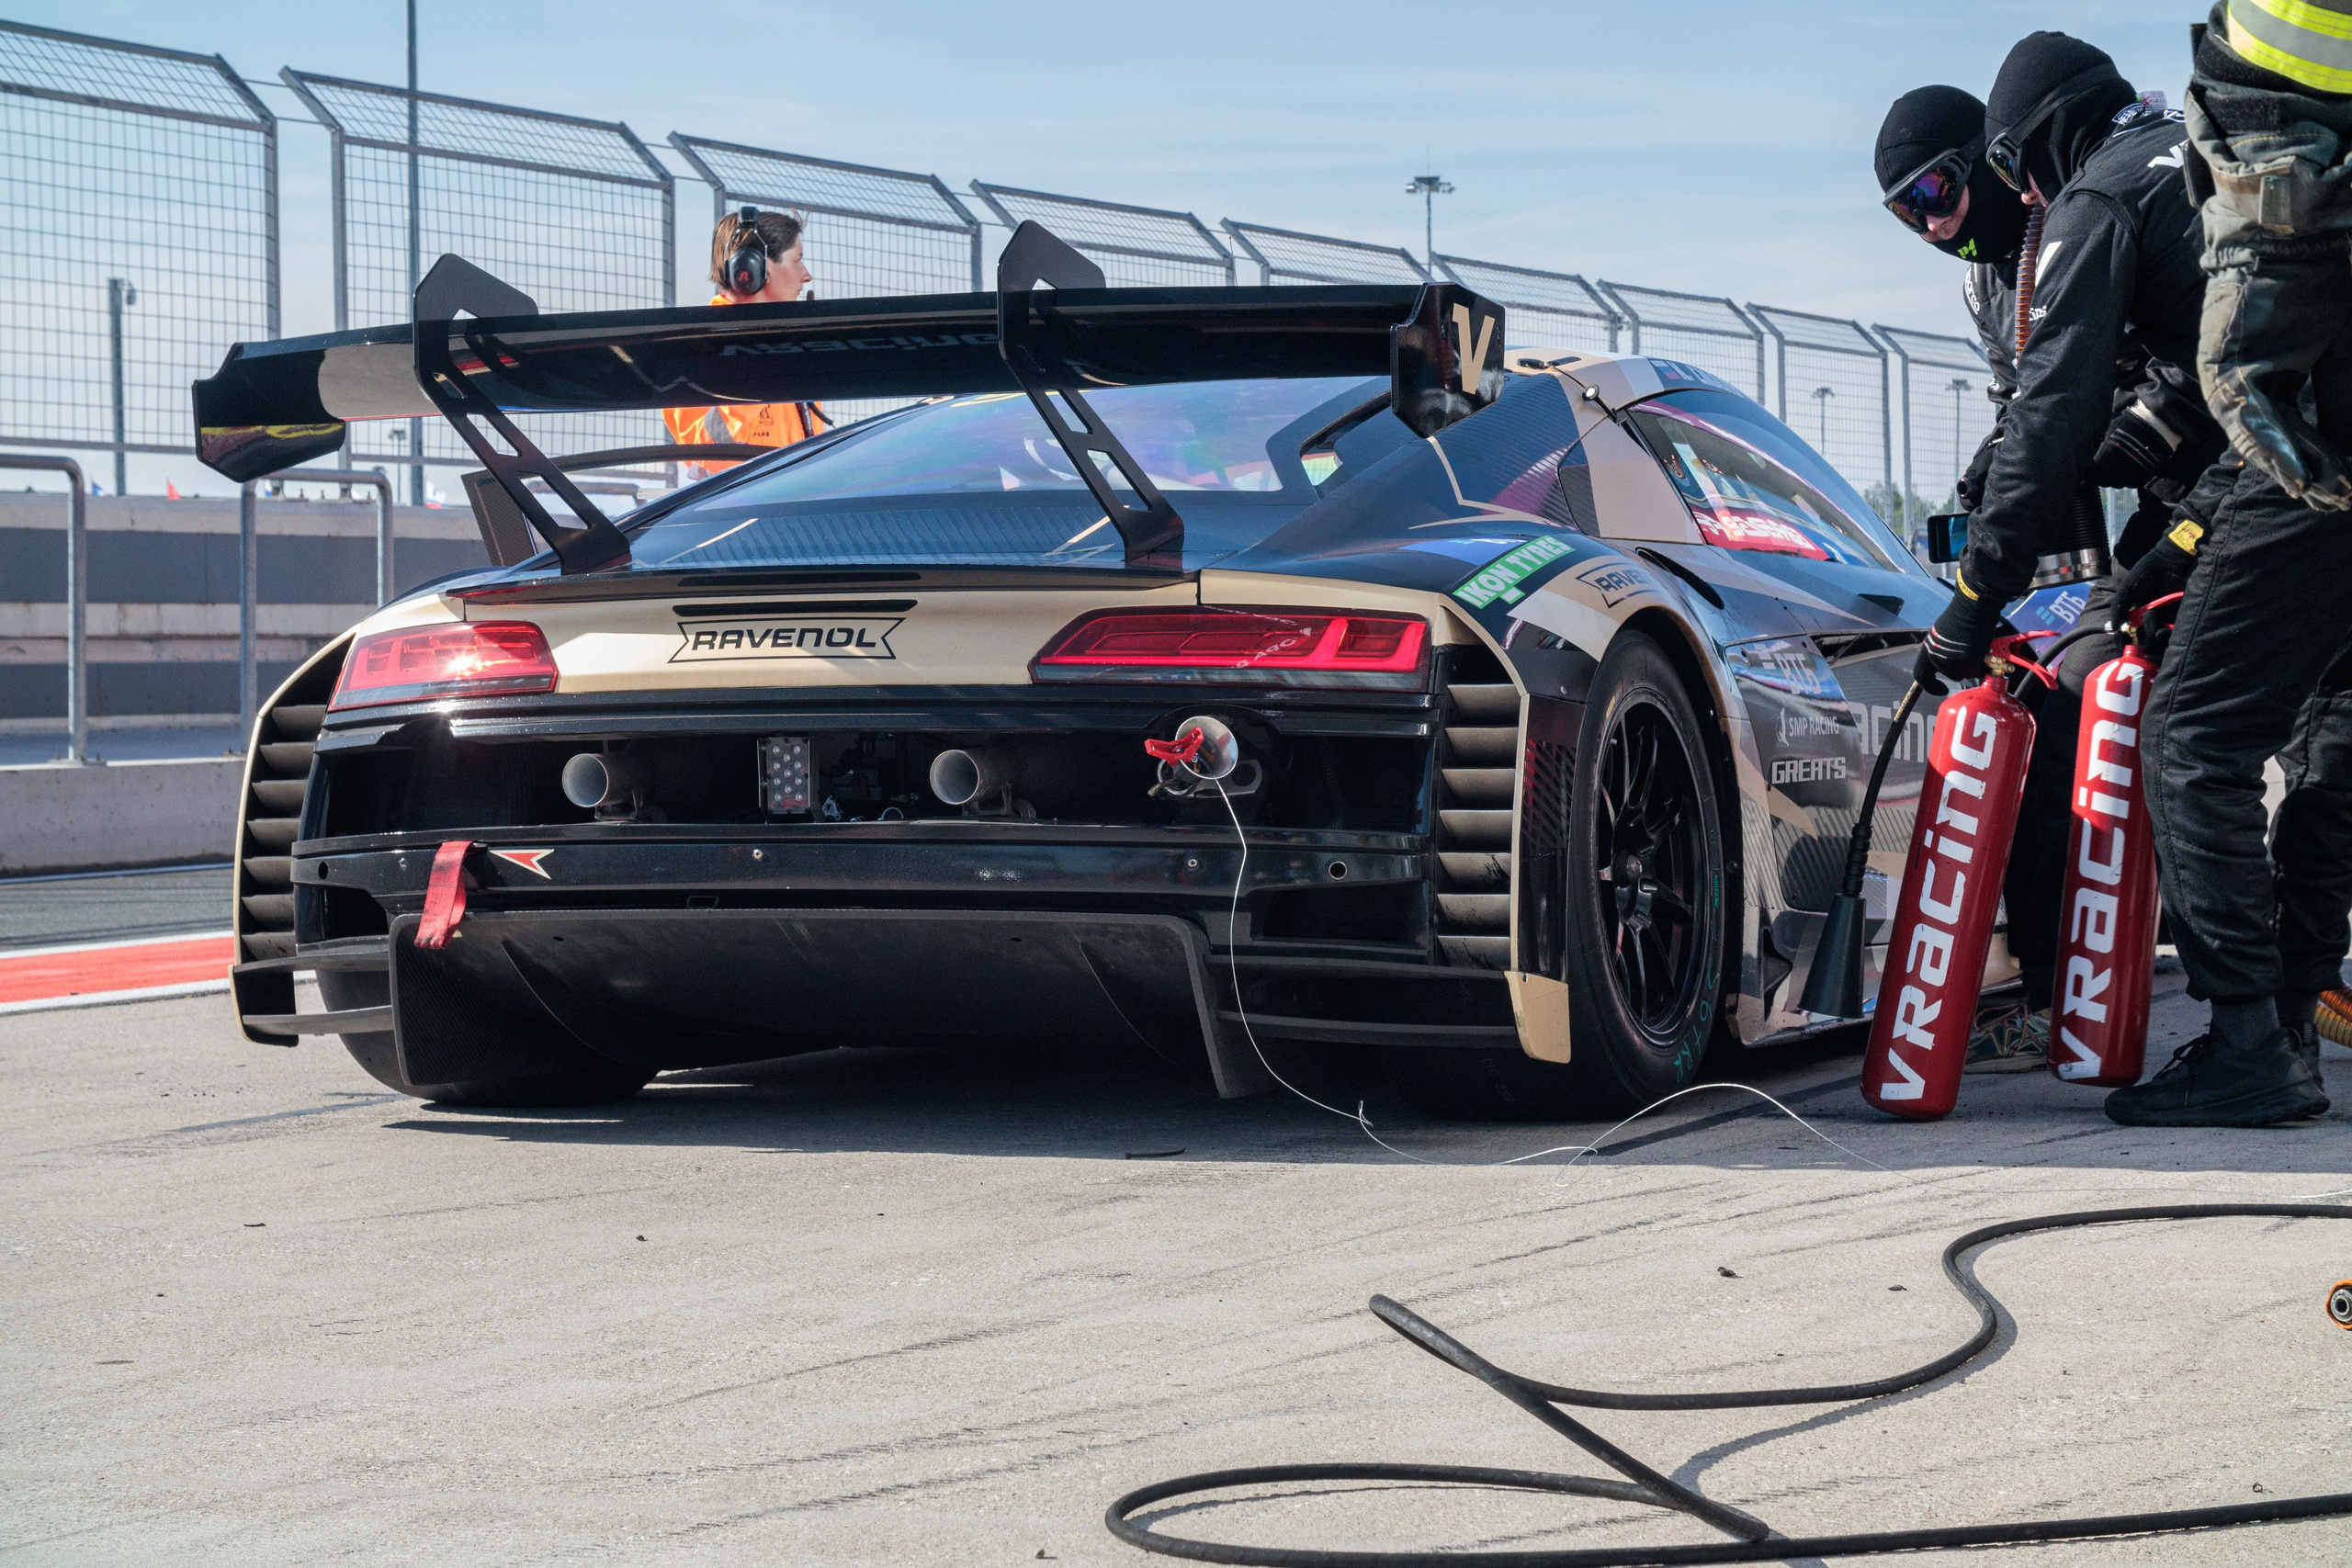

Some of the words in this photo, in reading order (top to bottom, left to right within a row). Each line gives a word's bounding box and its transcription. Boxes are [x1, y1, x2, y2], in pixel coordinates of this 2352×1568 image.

[1452, 302, 1496, 395] V
[1457, 563, 1521, 607] IKON
[1508, 536, 1572, 571] TYRES
[692, 627, 877, 651] RAVENOL
[1789, 717, 1808, 737] SMP
[1809, 716, 1839, 735] RACING
[1771, 756, 1847, 784] GREATS
